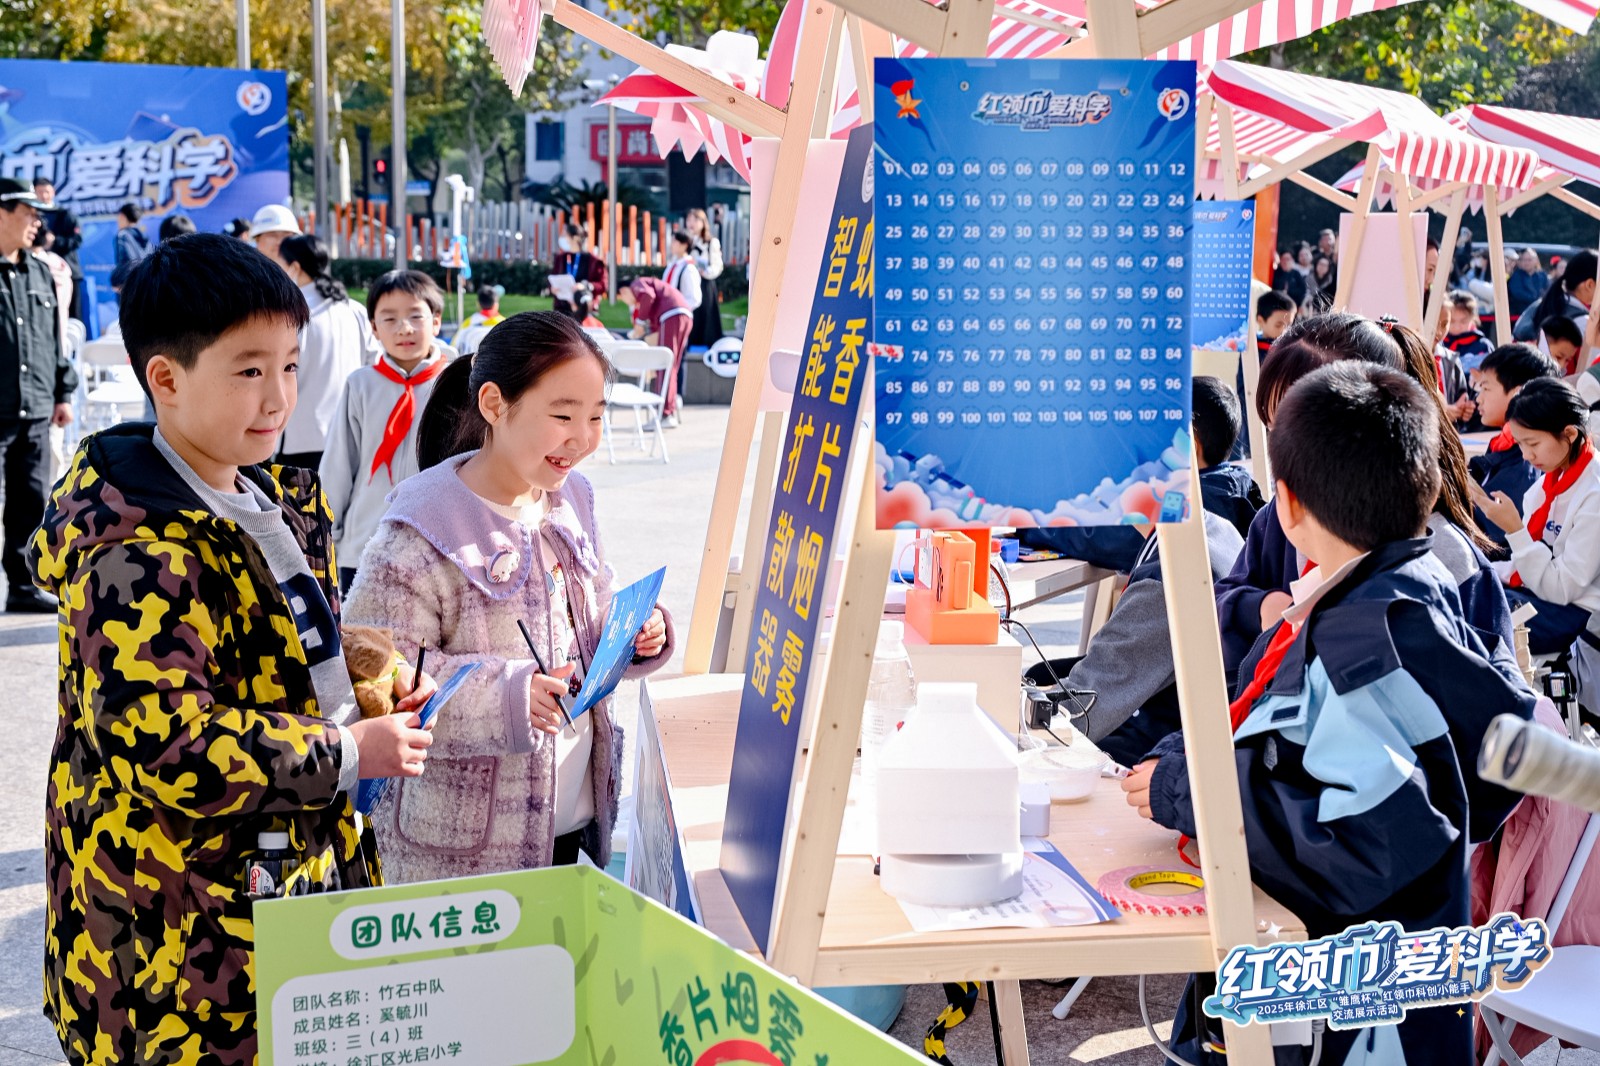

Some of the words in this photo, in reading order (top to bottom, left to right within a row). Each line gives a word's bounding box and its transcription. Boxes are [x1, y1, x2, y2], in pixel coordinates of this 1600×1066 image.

[886, 163, 901, 175] 01
[911, 164, 928, 175] 02
[937, 163, 954, 175] 03
[963, 164, 981, 175] 04
[989, 164, 1006, 175] 05
[1015, 164, 1032, 175] 06
[1041, 164, 1058, 175] 07
[1066, 164, 1084, 176] 08
[1092, 164, 1110, 176] 09
[1118, 164, 1134, 176] 10
[1144, 164, 1159, 175] 11
[1169, 164, 1185, 176] 12
[886, 195, 902, 207] 13
[912, 195, 929, 207] 14
[938, 195, 955, 207] 15
[964, 195, 981, 207] 16
[990, 195, 1006, 206] 17
[1016, 195, 1032, 207] 18
[1042, 195, 1058, 206] 19
[1066, 195, 1084, 207] 20
[1092, 195, 1107, 207] 21
[1117, 195, 1134, 207] 22
[1143, 195, 1159, 207] 23
[1168, 195, 1185, 207] 24
[885, 226, 903, 238] 25
[912, 227, 929, 238] 26
[938, 226, 954, 238] 27
[964, 226, 981, 238] 28
[989, 226, 1006, 238] 29
[1016, 226, 1032, 238] 30
[1042, 226, 1056, 238] 31
[1067, 226, 1083, 238] 32
[1092, 226, 1108, 238] 33
[1118, 226, 1134, 238] 34
[1143, 226, 1159, 238] 35
[1168, 226, 1184, 238] 36
[886, 258, 903, 270] 37
[912, 258, 929, 270] 38
[938, 258, 955, 270] 39
[963, 258, 980, 269] 40
[989, 258, 1005, 269] 41
[1014, 257, 1031, 269] 42
[1040, 257, 1057, 269] 43
[1066, 258, 1082, 268] 44
[1091, 257, 1108, 269] 45
[1116, 257, 1133, 268] 46
[1141, 257, 1158, 268] 47
[1167, 257, 1184, 268] 48
[885, 289, 903, 301] 49
[911, 289, 929, 301] 50
[938, 289, 953, 301] 51
[963, 289, 980, 300] 52
[989, 289, 1005, 300] 53
[1015, 288, 1031, 300] 54
[1040, 288, 1057, 300] 55
[1066, 288, 1082, 300] 56
[1091, 288, 1107, 299] 57
[1116, 288, 1133, 299] 58
[1141, 288, 1158, 299] 59
[1166, 287, 1183, 299] 60
[885, 320, 901, 332] 61
[911, 320, 928, 332] 62
[937, 320, 954, 332] 63
[963, 320, 980, 331] 64
[988, 320, 1006, 331] 65
[1014, 320, 1031, 331] 66
[1039, 319, 1056, 331] 67
[1065, 319, 1082, 330] 68
[1090, 319, 1107, 330] 69
[1116, 318, 1133, 330] 70
[1142, 318, 1156, 329] 71
[1167, 318, 1183, 330] 72
[912, 351, 929, 362] 74
[938, 351, 954, 362] 75
[963, 351, 980, 362] 76
[989, 350, 1005, 361] 77
[1015, 350, 1031, 361] 78
[1040, 350, 1057, 361] 79
[1065, 349, 1082, 361] 80
[1090, 349, 1106, 361] 81
[1115, 349, 1132, 360] 82
[1140, 349, 1157, 360] 83
[1165, 348, 1182, 360] 84
[885, 382, 903, 394] 85
[911, 382, 929, 394] 86
[937, 381, 954, 393] 87
[963, 381, 980, 393] 88
[988, 381, 1006, 392] 89
[1014, 381, 1031, 392] 90
[1039, 380, 1055, 391] 91
[1064, 380, 1081, 391] 92
[1090, 380, 1106, 391] 93
[1115, 379, 1131, 390] 94
[1140, 379, 1157, 390] 95
[1165, 379, 1182, 390] 96
[885, 413, 903, 425] 97
[911, 412, 929, 424] 98
[937, 412, 954, 424] 99
[961, 413, 981, 423] 100
[987, 413, 1006, 423] 101
[1013, 412, 1032, 423] 102
[1038, 412, 1057, 422] 103
[1063, 412, 1083, 422] 104
[1088, 411, 1108, 421] 105
[1113, 411, 1133, 421] 106
[1138, 410, 1158, 421] 107
[1163, 410, 1183, 420] 108
[751, 215, 859, 698] 智能扩散器
[351, 901, 501, 949] 团队信息
